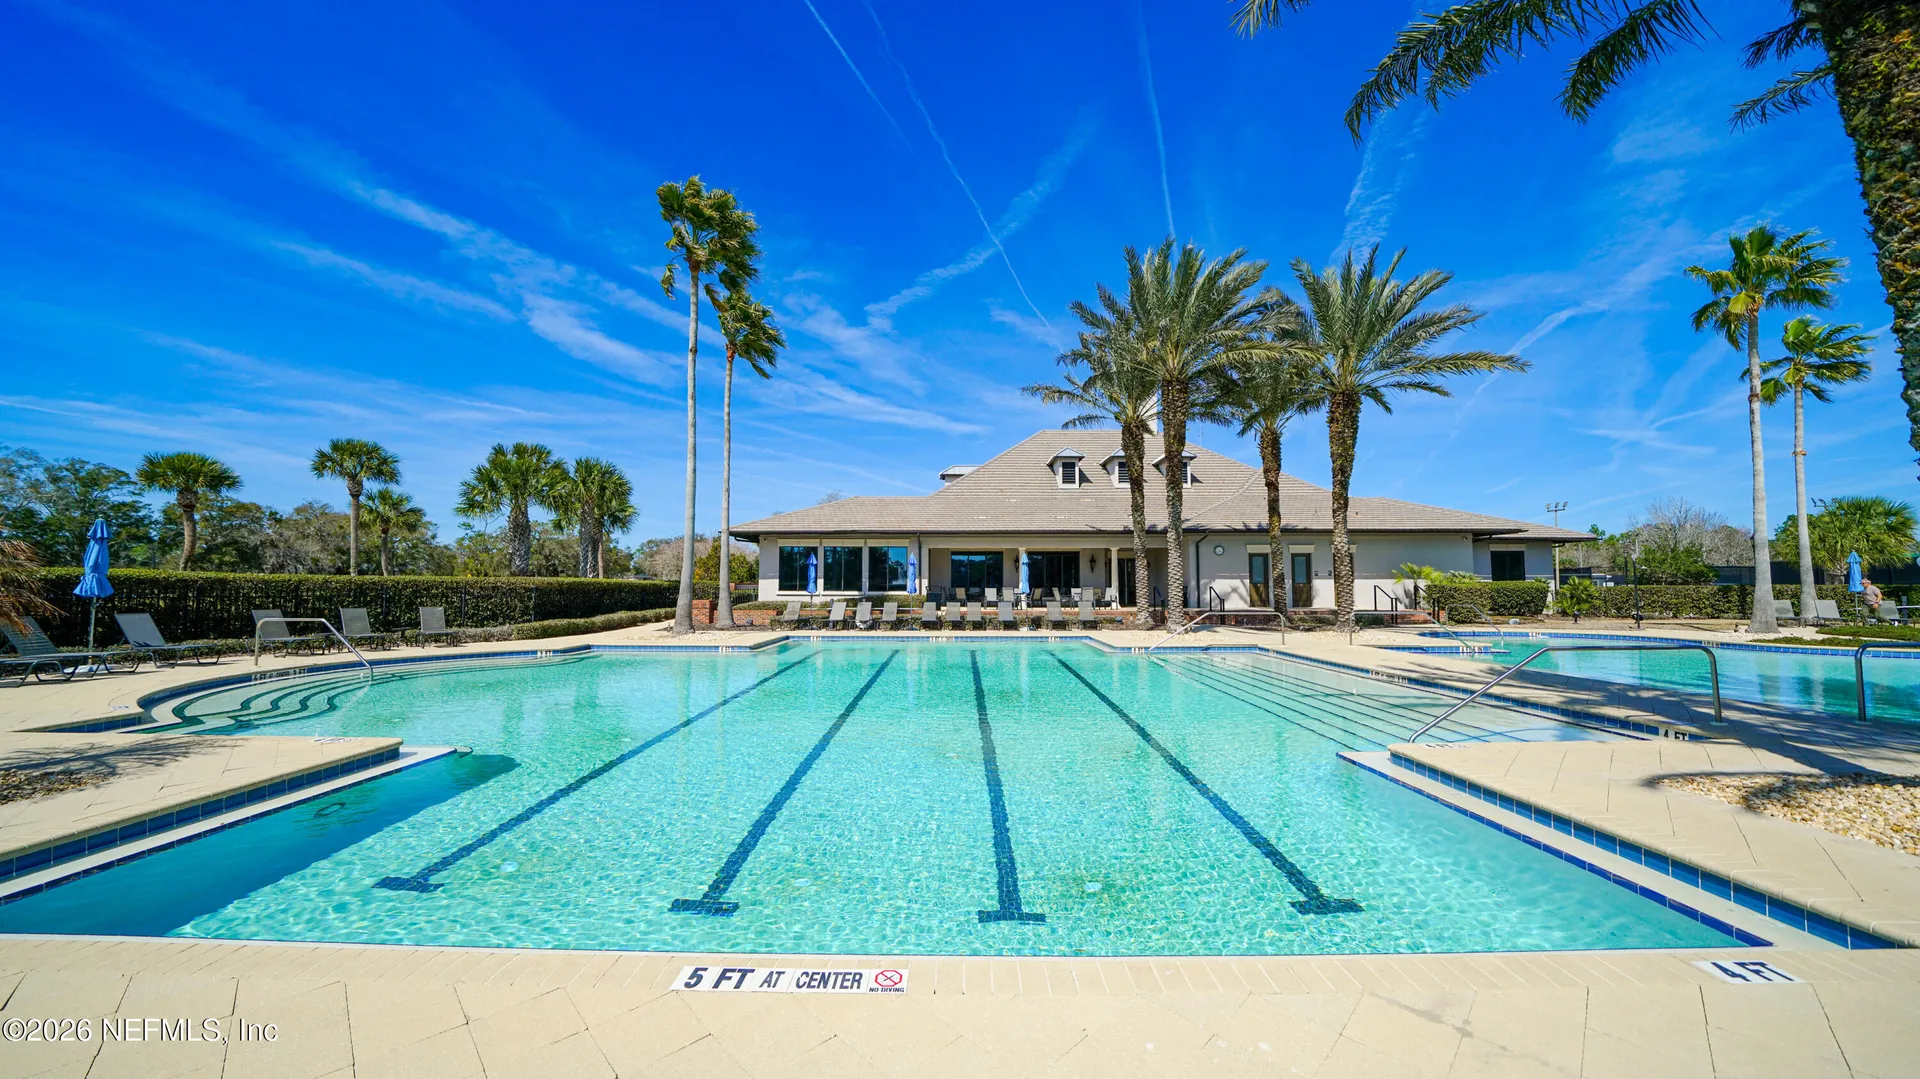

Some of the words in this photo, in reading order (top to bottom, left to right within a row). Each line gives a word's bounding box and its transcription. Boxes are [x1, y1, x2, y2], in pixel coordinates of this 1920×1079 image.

[1675, 731, 1688, 740] FT
[684, 967, 709, 989] 5
[712, 968, 756, 990] FT
[759, 970, 786, 989] AT
[795, 971, 863, 990] CENTER
[1710, 961, 1752, 982] 4
[1732, 961, 1795, 982] FT
